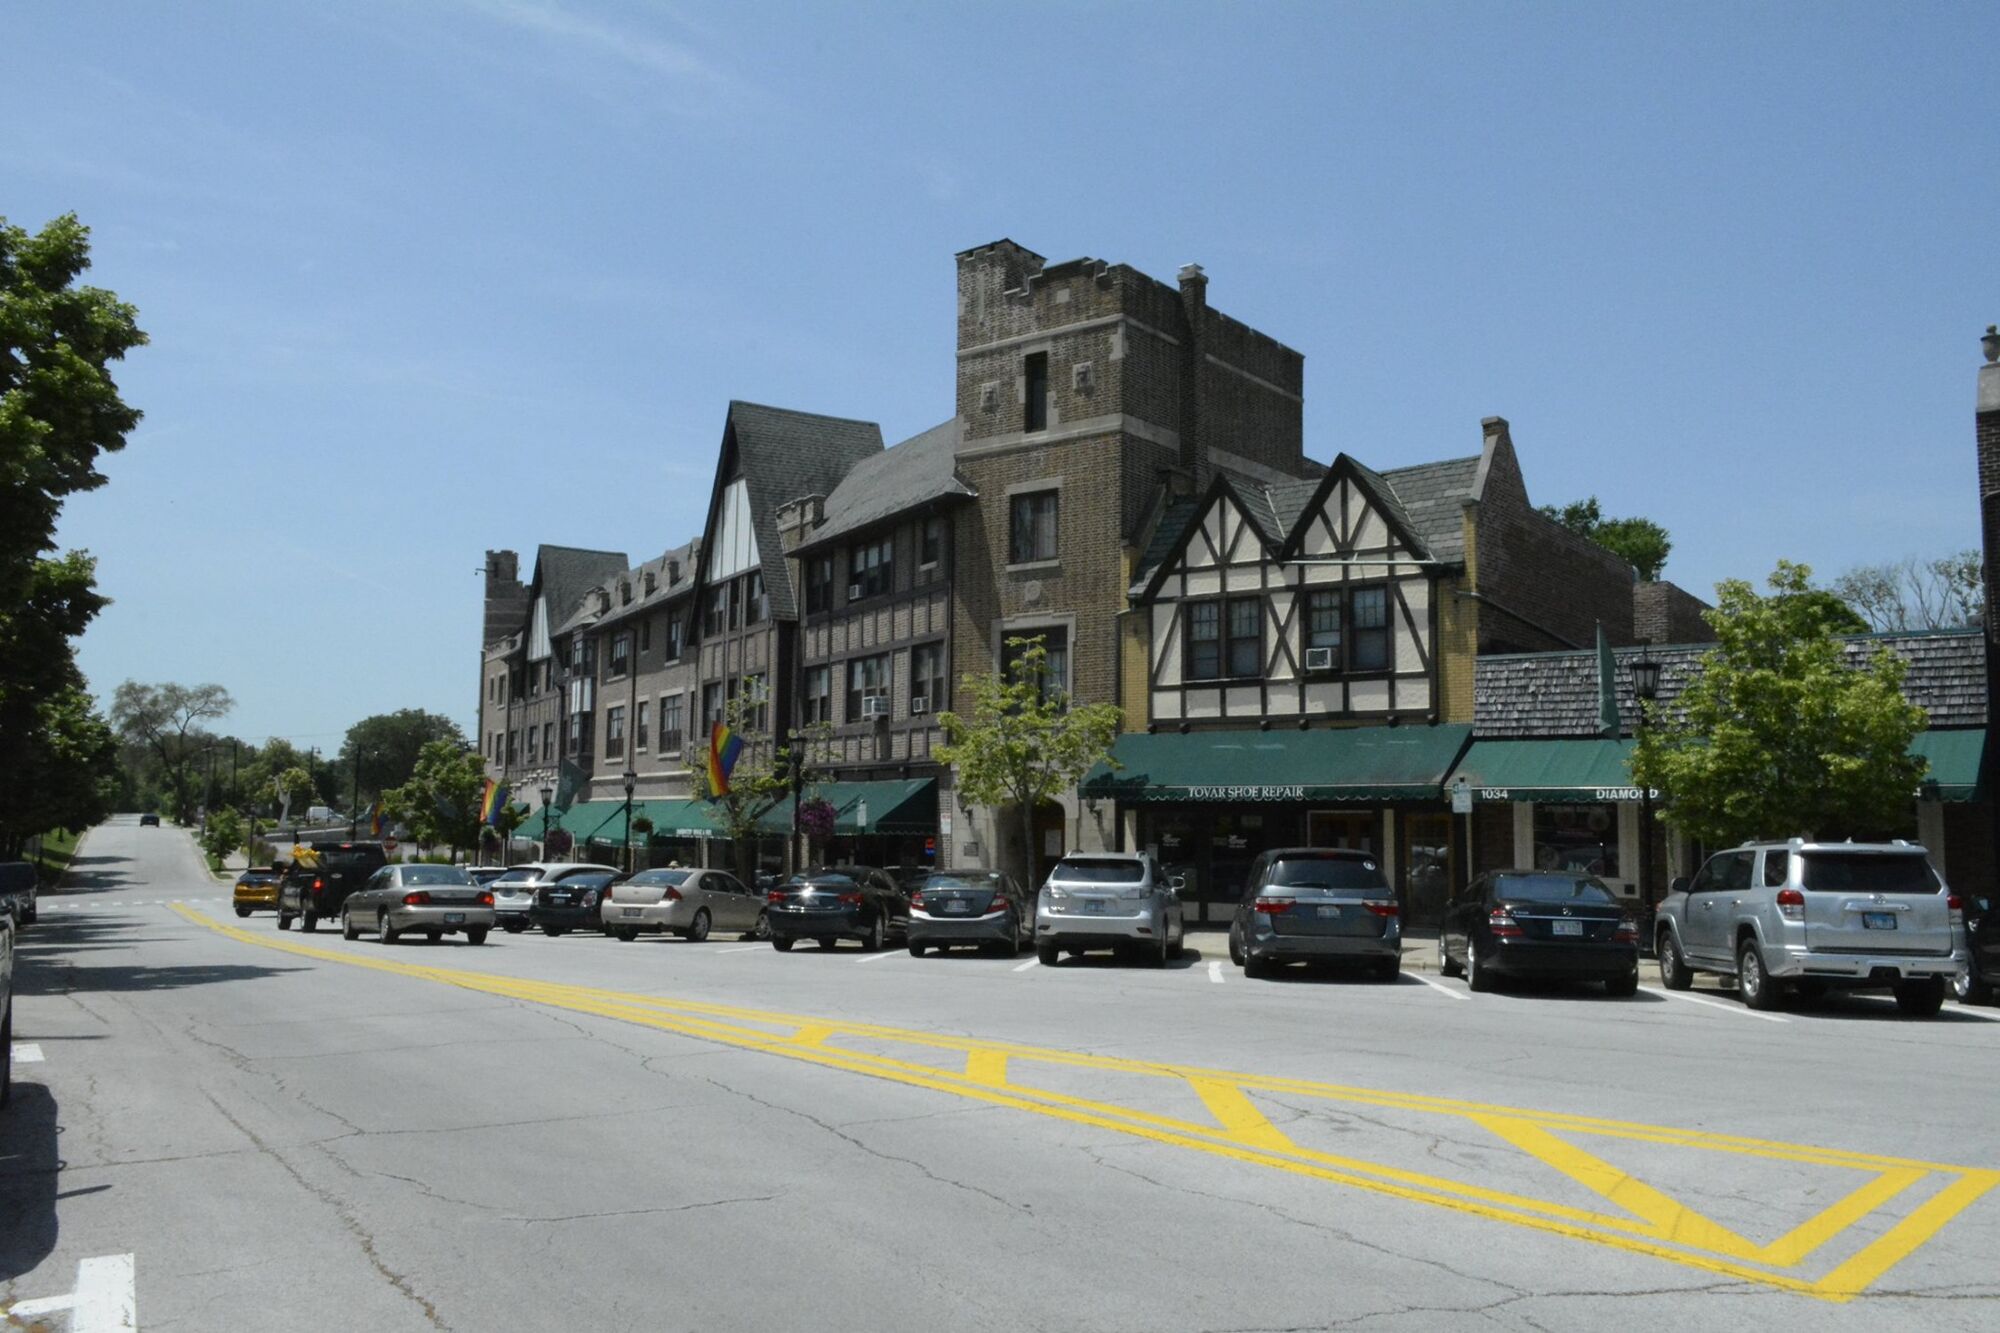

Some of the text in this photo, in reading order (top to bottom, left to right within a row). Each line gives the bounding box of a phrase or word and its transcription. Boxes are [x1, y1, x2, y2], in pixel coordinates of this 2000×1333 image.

[1189, 786, 1303, 797] TOVAR SHOE REPAIR
[1481, 789, 1508, 799] 1034
